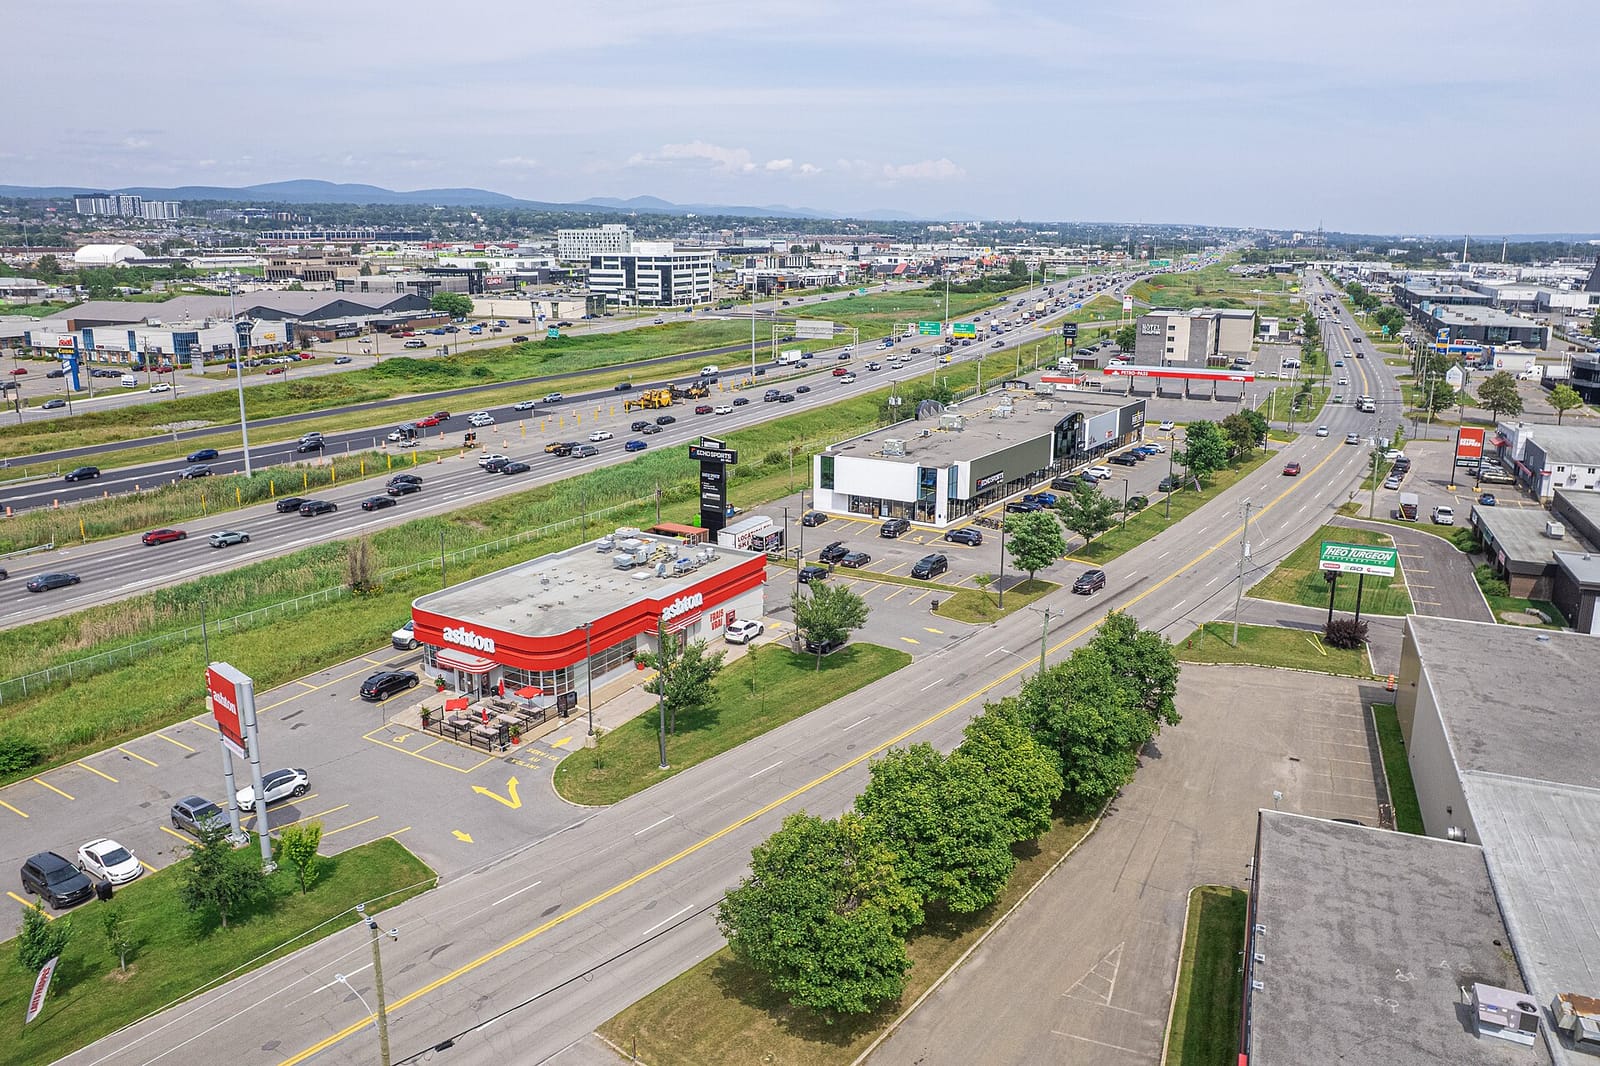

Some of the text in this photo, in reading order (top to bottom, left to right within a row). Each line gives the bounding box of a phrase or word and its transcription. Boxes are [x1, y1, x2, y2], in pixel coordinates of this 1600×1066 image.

[710, 451, 732, 460] SPORTS
[1348, 548, 1395, 561] TURGEON
[661, 592, 704, 621] ashton
[443, 626, 496, 654] ashton
[213, 690, 237, 716] ashton
